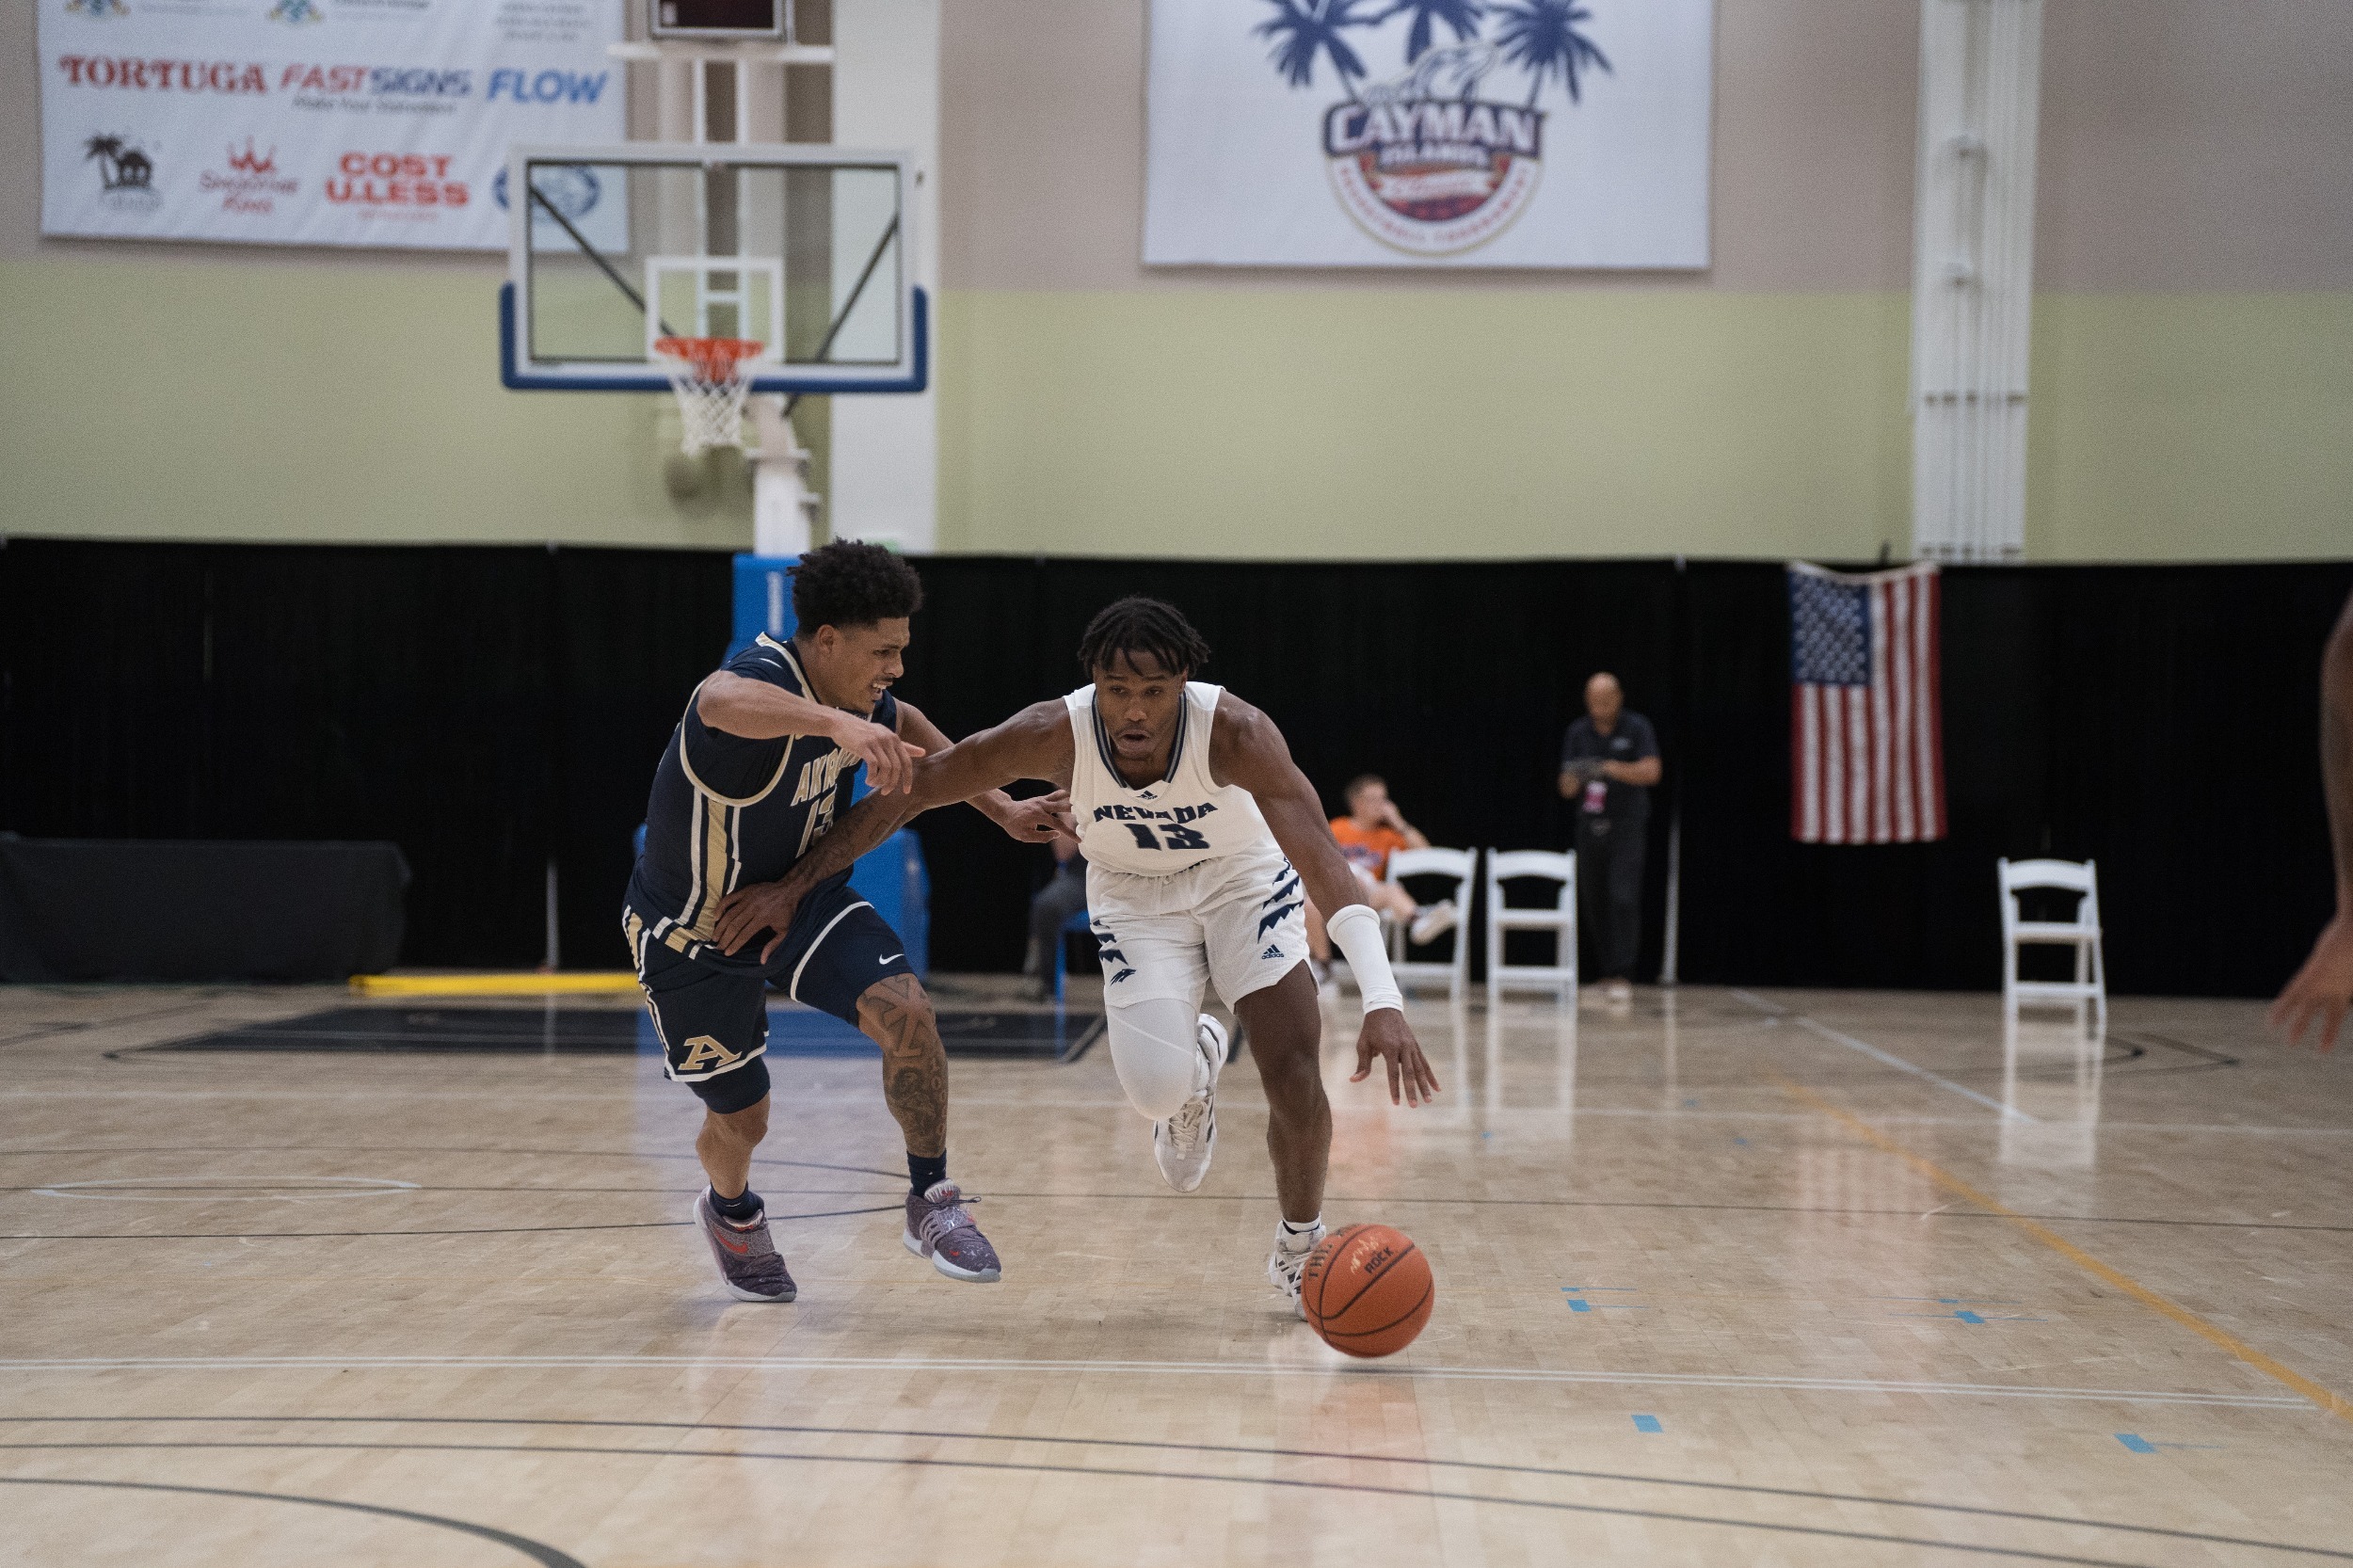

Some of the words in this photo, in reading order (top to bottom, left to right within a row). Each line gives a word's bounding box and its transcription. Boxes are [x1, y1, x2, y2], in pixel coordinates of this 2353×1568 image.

[57, 54, 268, 95] TORTUGA
[280, 63, 473, 97] FASTSIGNS
[486, 67, 609, 105] FLOW
[1328, 102, 1538, 152] CAYMAN
[340, 152, 454, 179] COST
[1093, 802, 1219, 824] NEVADA
[1123, 823, 1210, 852] 13
[678, 1034, 743, 1071] A
